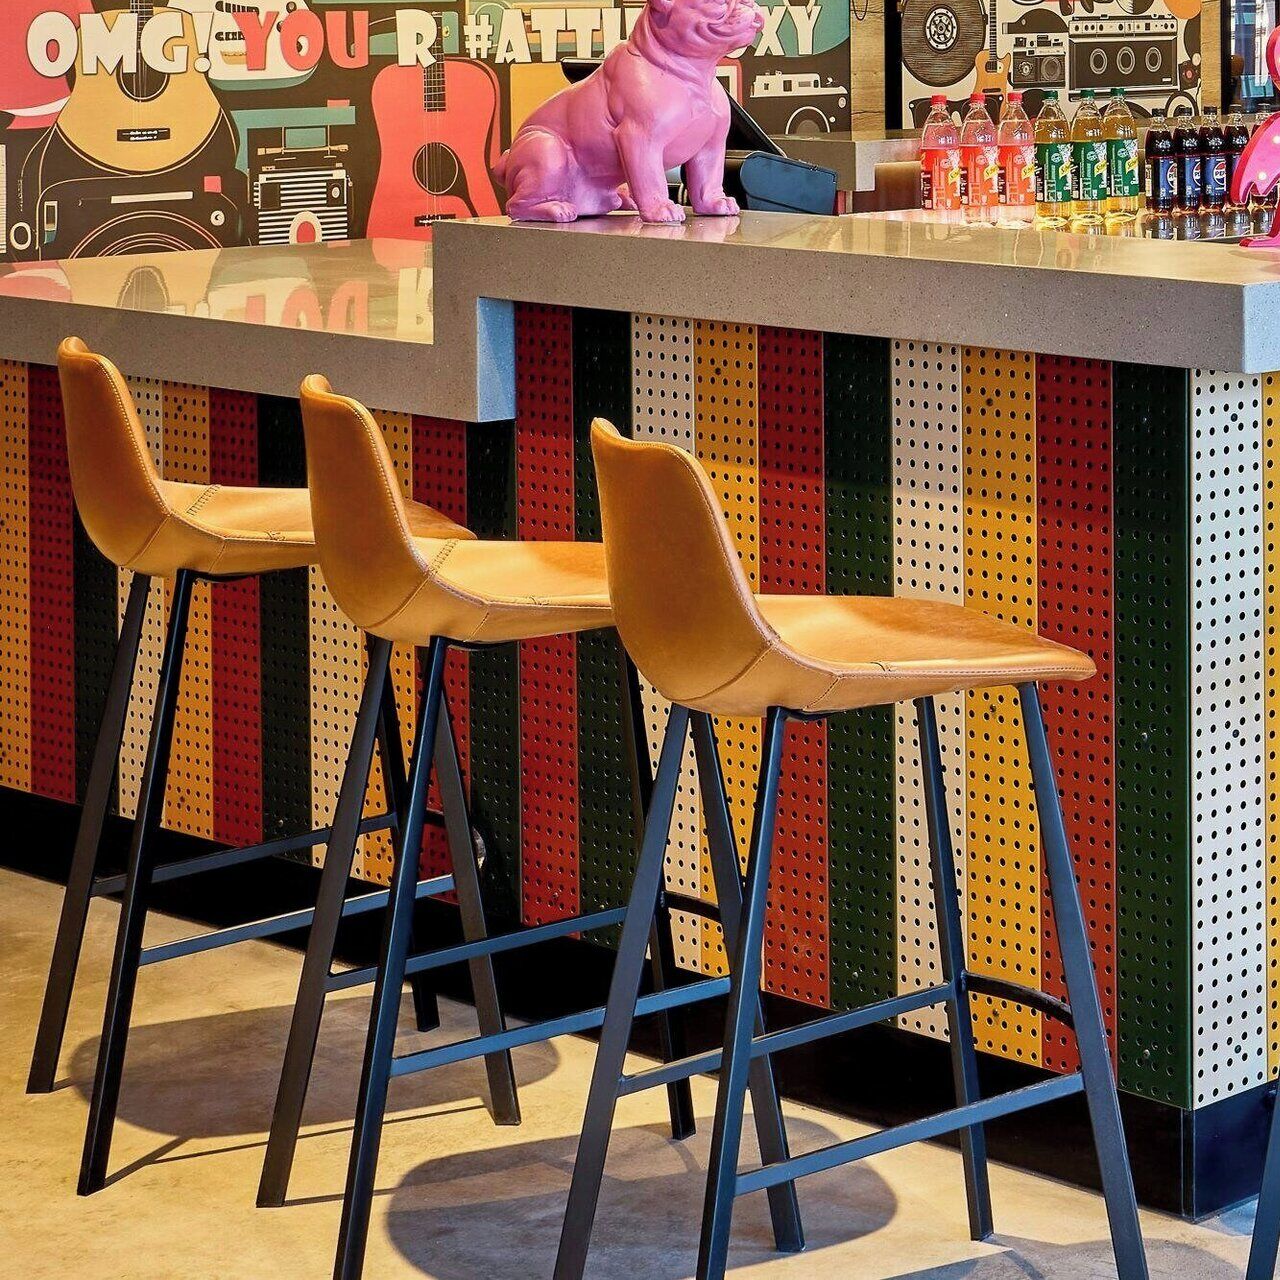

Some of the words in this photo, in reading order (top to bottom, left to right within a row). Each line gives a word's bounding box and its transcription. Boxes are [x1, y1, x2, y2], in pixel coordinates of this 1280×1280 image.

[26, 10, 214, 77] OMG!
[232, 9, 369, 71] YOU
[396, 9, 437, 68] R
